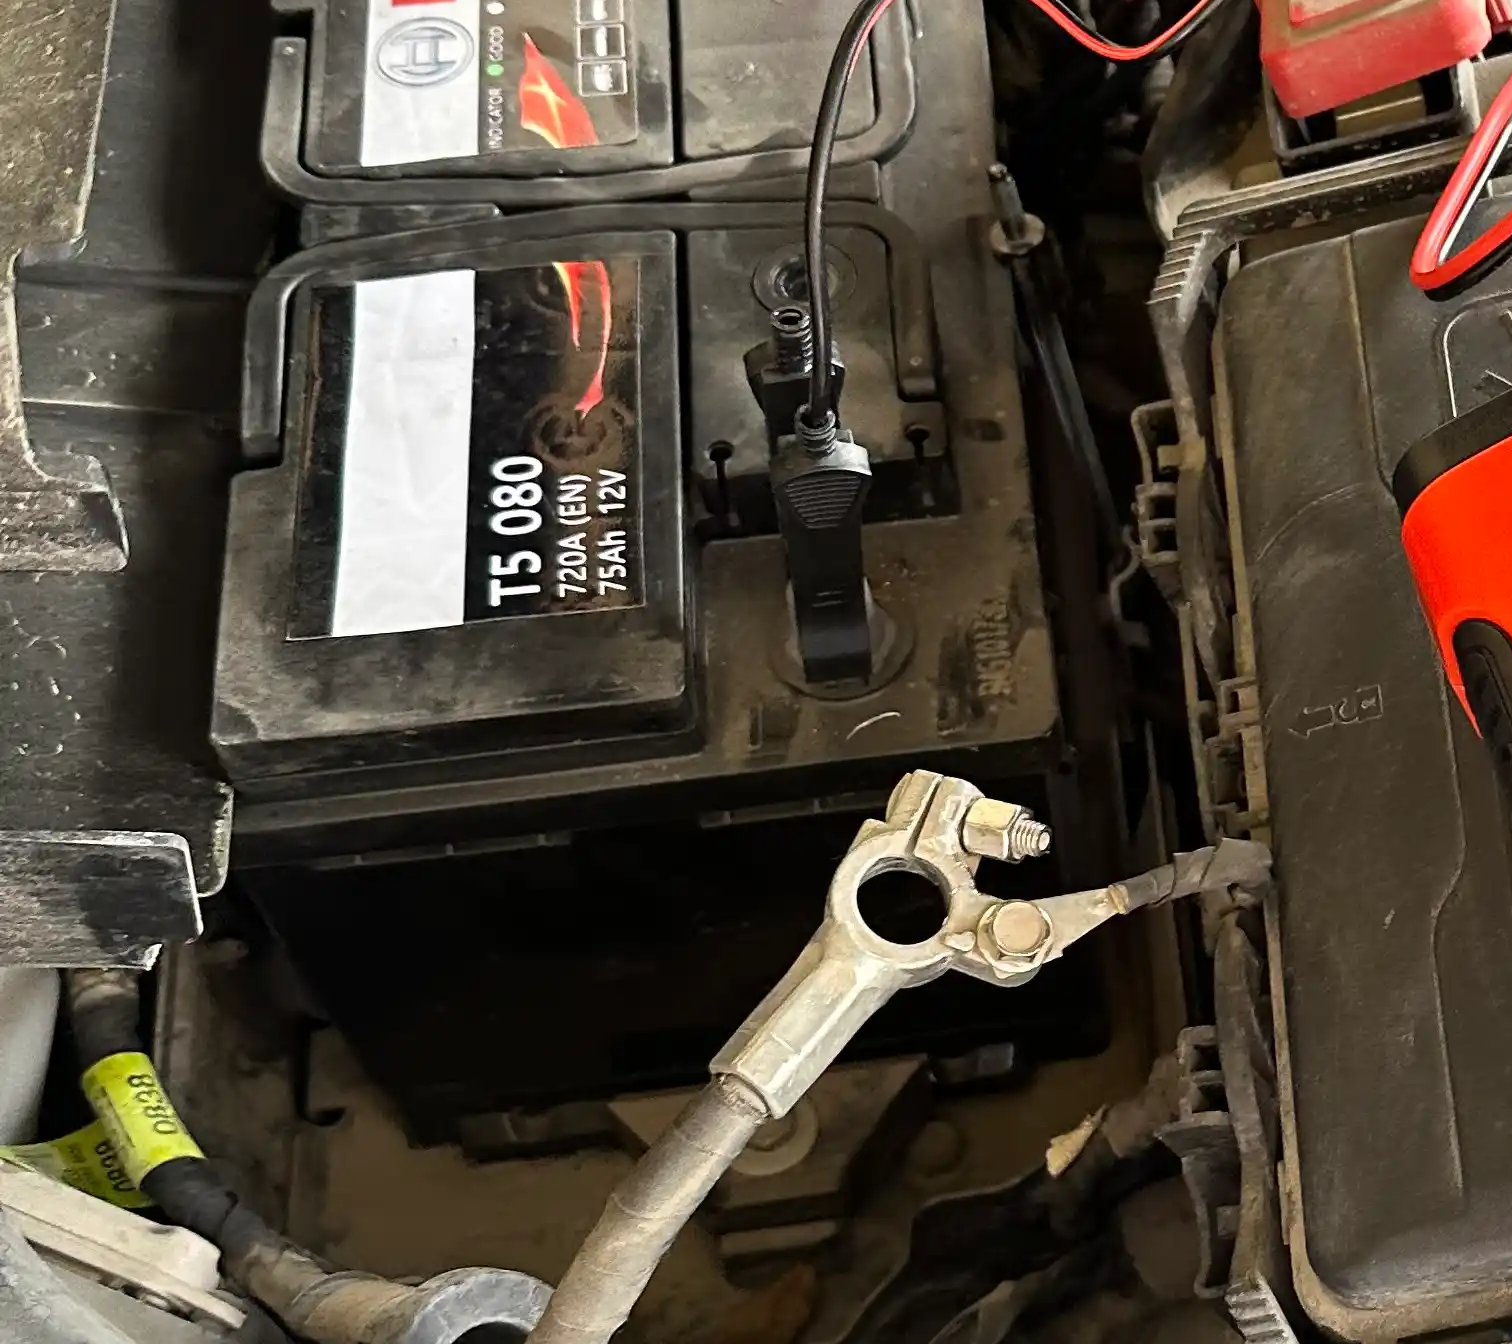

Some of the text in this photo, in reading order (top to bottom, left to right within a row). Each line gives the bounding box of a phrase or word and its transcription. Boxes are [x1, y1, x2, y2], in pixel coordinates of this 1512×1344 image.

[488, 25, 505, 62] GOOD
[488, 87, 504, 149] INDICATOR
[489, 456, 543, 607] T5 080
[558, 474, 592, 598] 720A (EN)
[597, 468, 627, 596] 75Ah 12V
